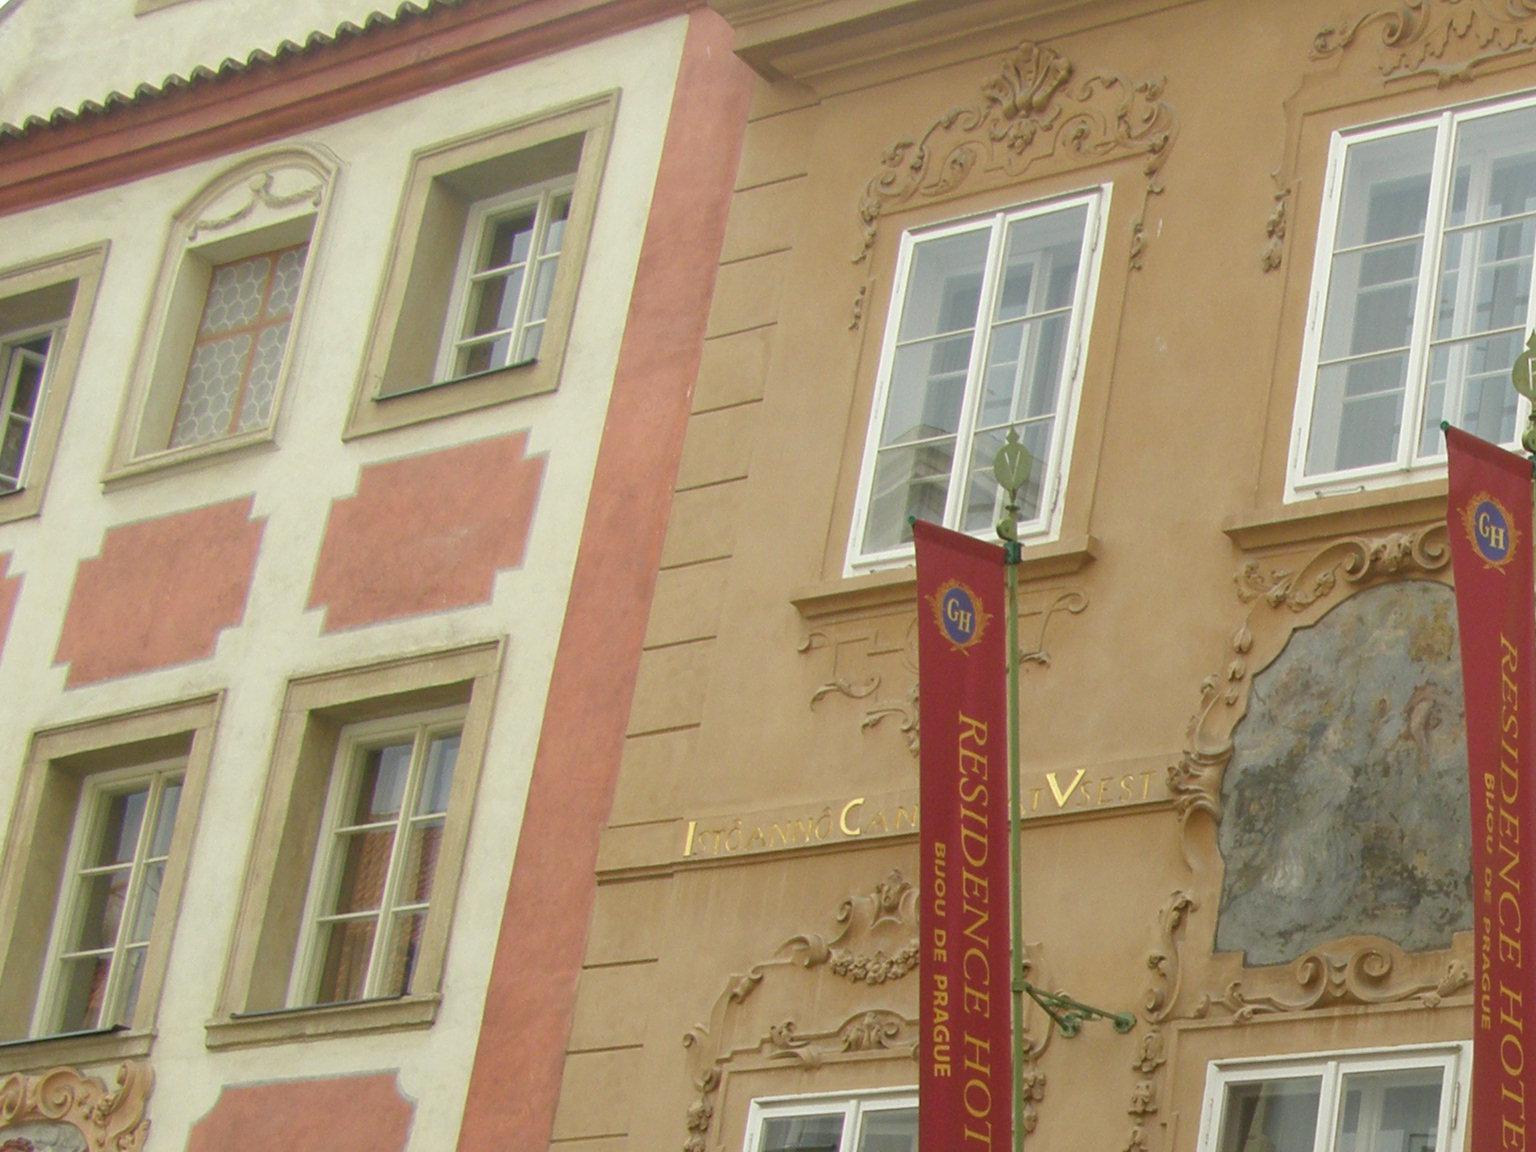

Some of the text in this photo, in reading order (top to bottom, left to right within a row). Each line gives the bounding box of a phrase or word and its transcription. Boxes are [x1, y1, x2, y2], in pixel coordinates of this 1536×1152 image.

[958, 710, 991, 1017] RESIDENCE
[1481, 772, 1496, 1031] BIJOU DE PRAGUE
[1499, 632, 1522, 969] RESIDENCE
[934, 842, 951, 1078] BIJOU DE PRAGUE
